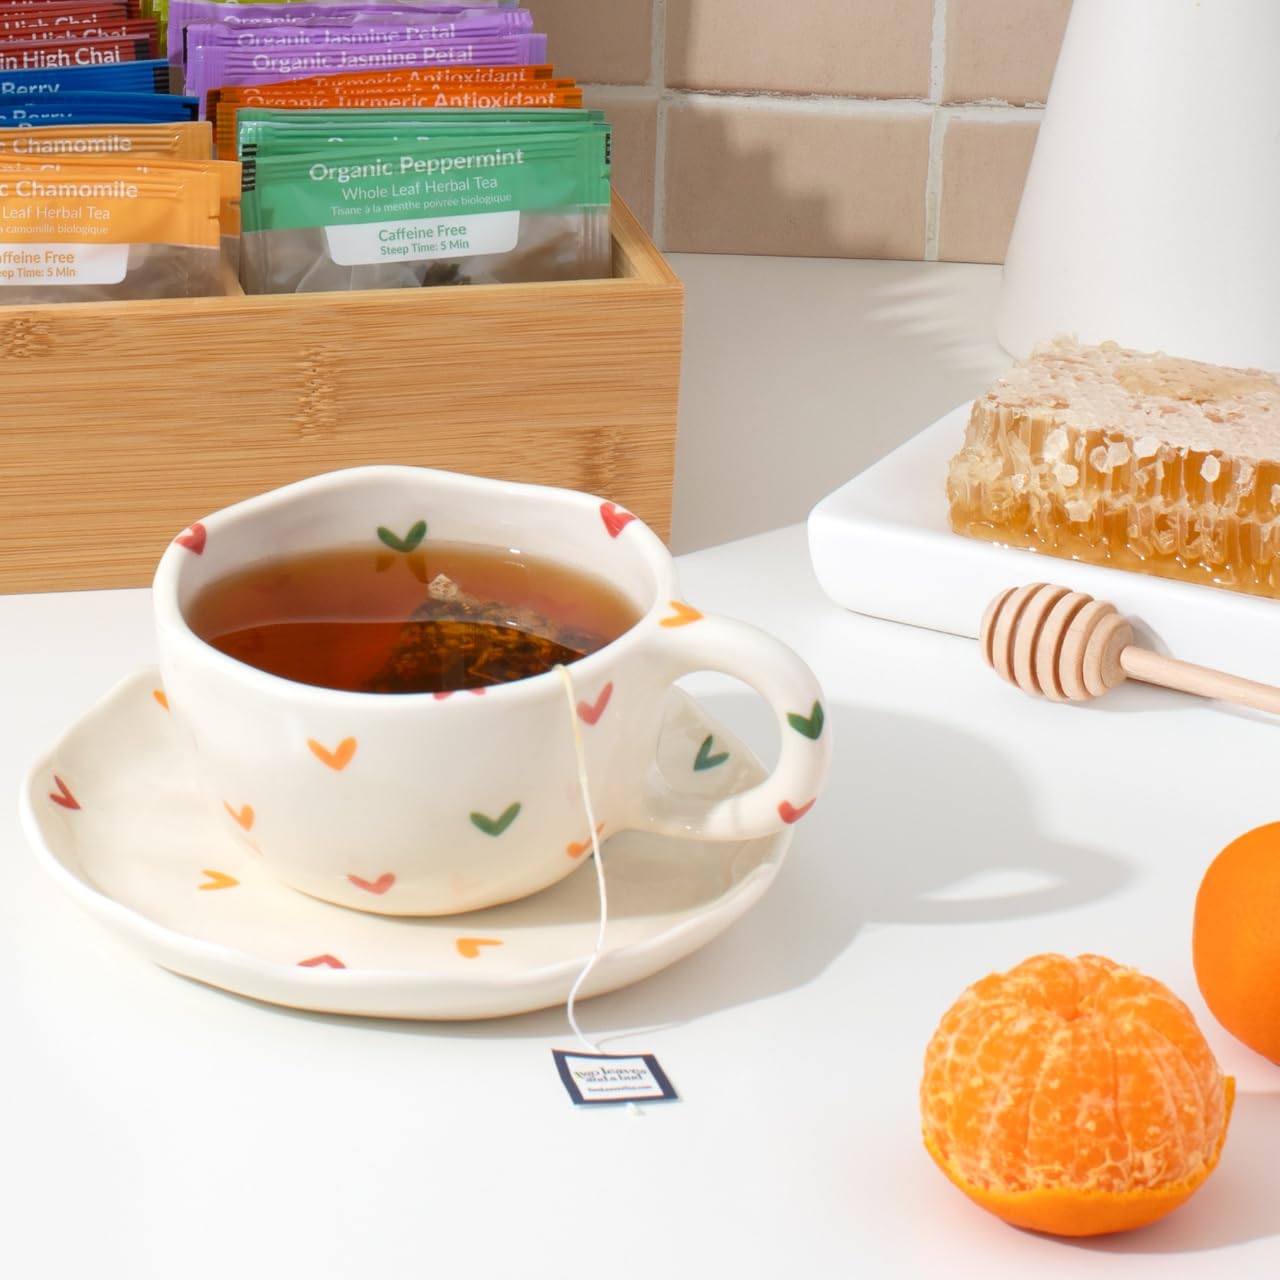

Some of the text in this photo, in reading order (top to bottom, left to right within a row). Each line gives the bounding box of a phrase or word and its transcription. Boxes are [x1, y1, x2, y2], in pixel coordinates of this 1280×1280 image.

[23, 48, 70, 69] High
[74, 45, 120, 65] Chai
[252, 45, 473, 72] Organic Jasmine Petal
[434, 91, 556, 108] Antioxidant
[13, 135, 132, 154] Chamomile
[309, 148, 524, 183] Organic Peppermint
[16, 179, 138, 198] Chamomile
[342, 176, 498, 201] Whole Leaf Herbal Tea
[2, 205, 32, 219] Leaf
[36, 205, 82, 219] Herbal
[86, 206, 111, 220] Tea
[384, 200, 420, 212] menthe
[378, 224, 467, 242] Caffeine Free
[380, 239, 469, 256] Steep Time: 5 Min
[45, 251, 75, 264] Free
[16, 267, 44, 278] Time:
[47, 267, 53, 277] 5
[56, 267, 76, 277] Min
